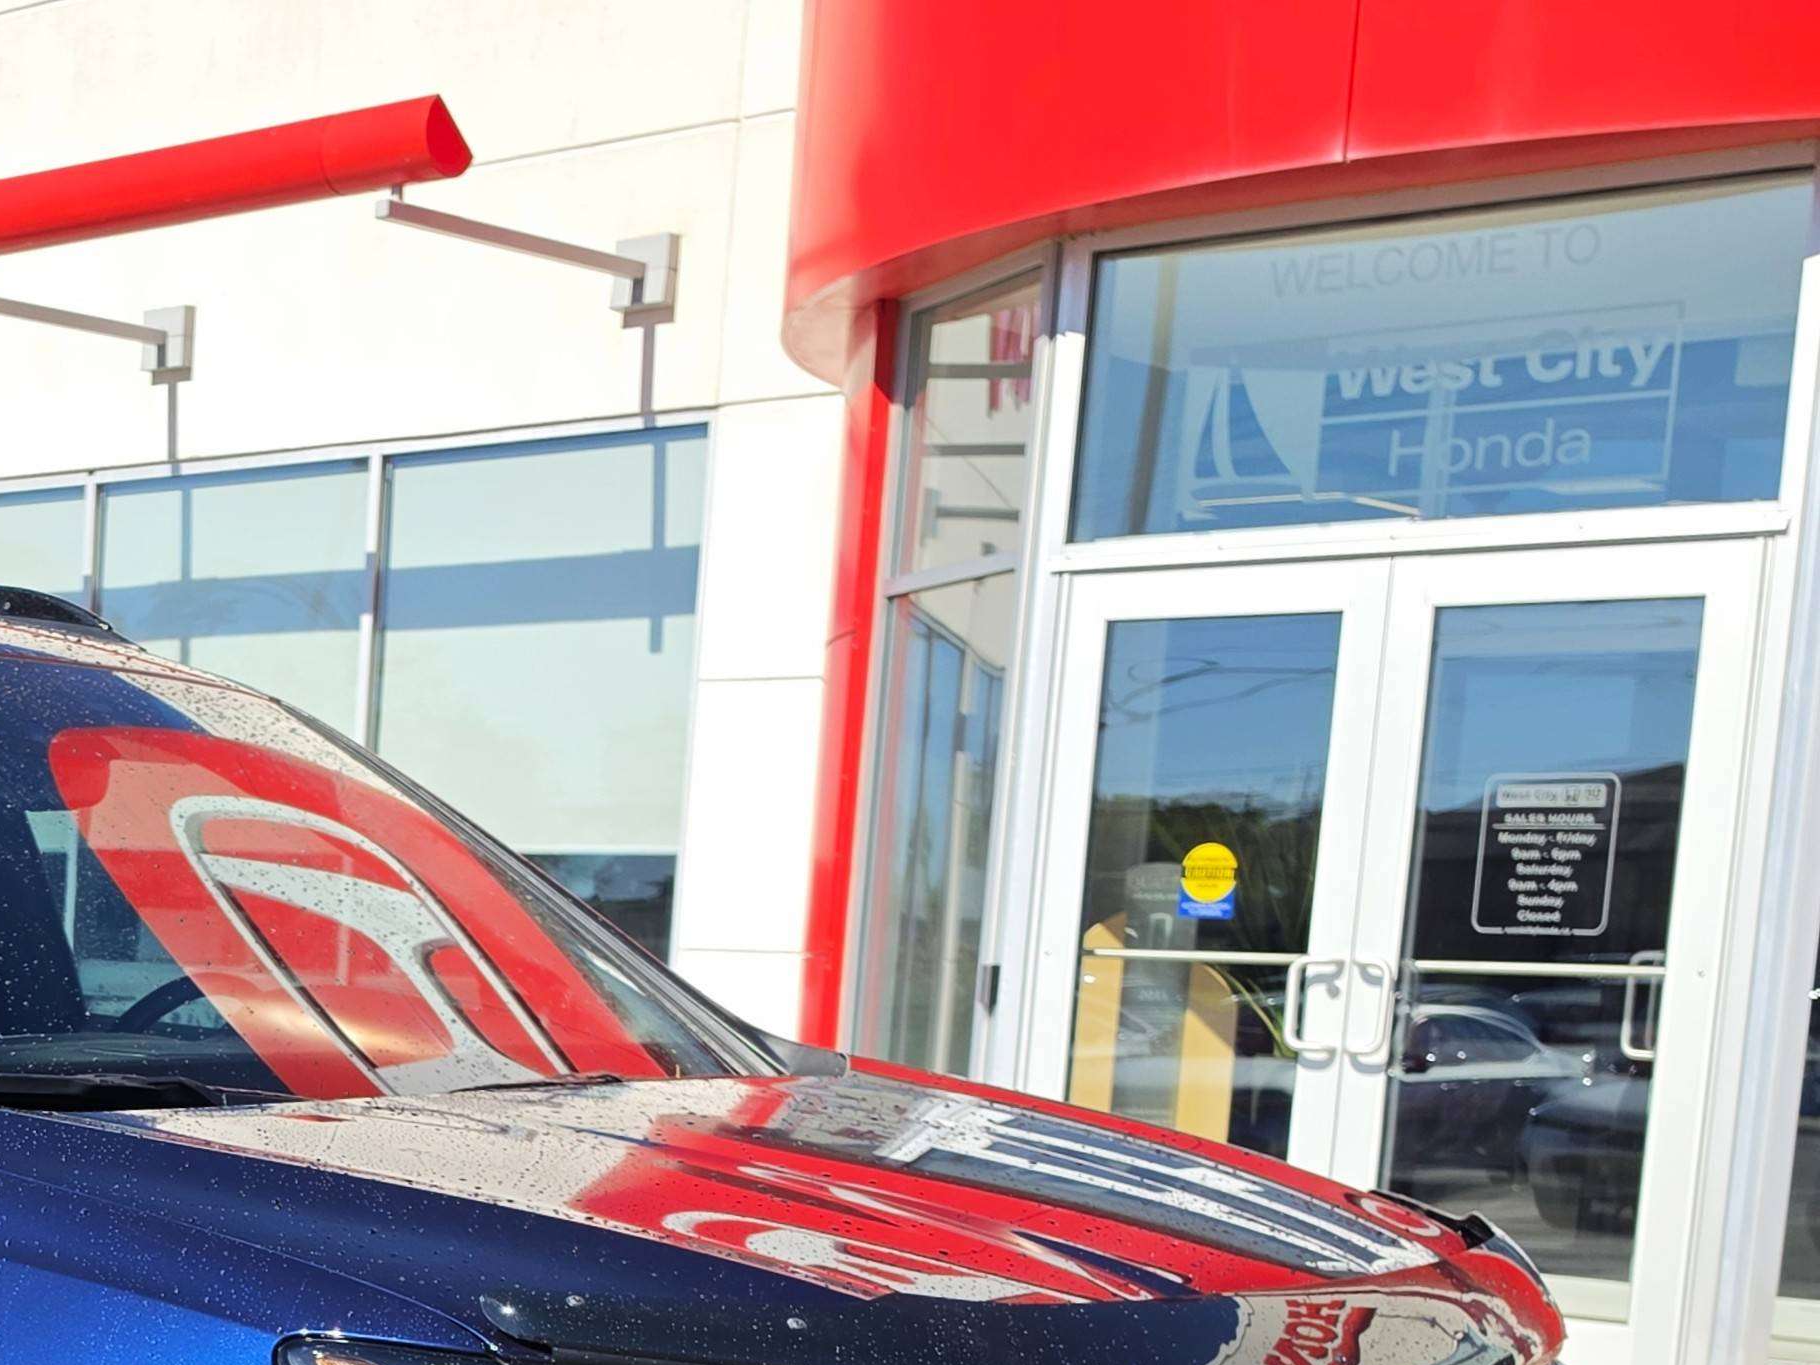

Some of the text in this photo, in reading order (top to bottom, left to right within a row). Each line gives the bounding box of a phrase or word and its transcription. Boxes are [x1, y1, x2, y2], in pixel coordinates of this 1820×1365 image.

[1270, 223, 1602, 298] WELCOME TO
[1330, 325, 1672, 400] West City
[1388, 417, 1592, 478] Honda
[1497, 831, 1547, 847] Monday
[1556, 831, 1597, 848] Friday
[1504, 812, 1596, 826] SALES HOURS
